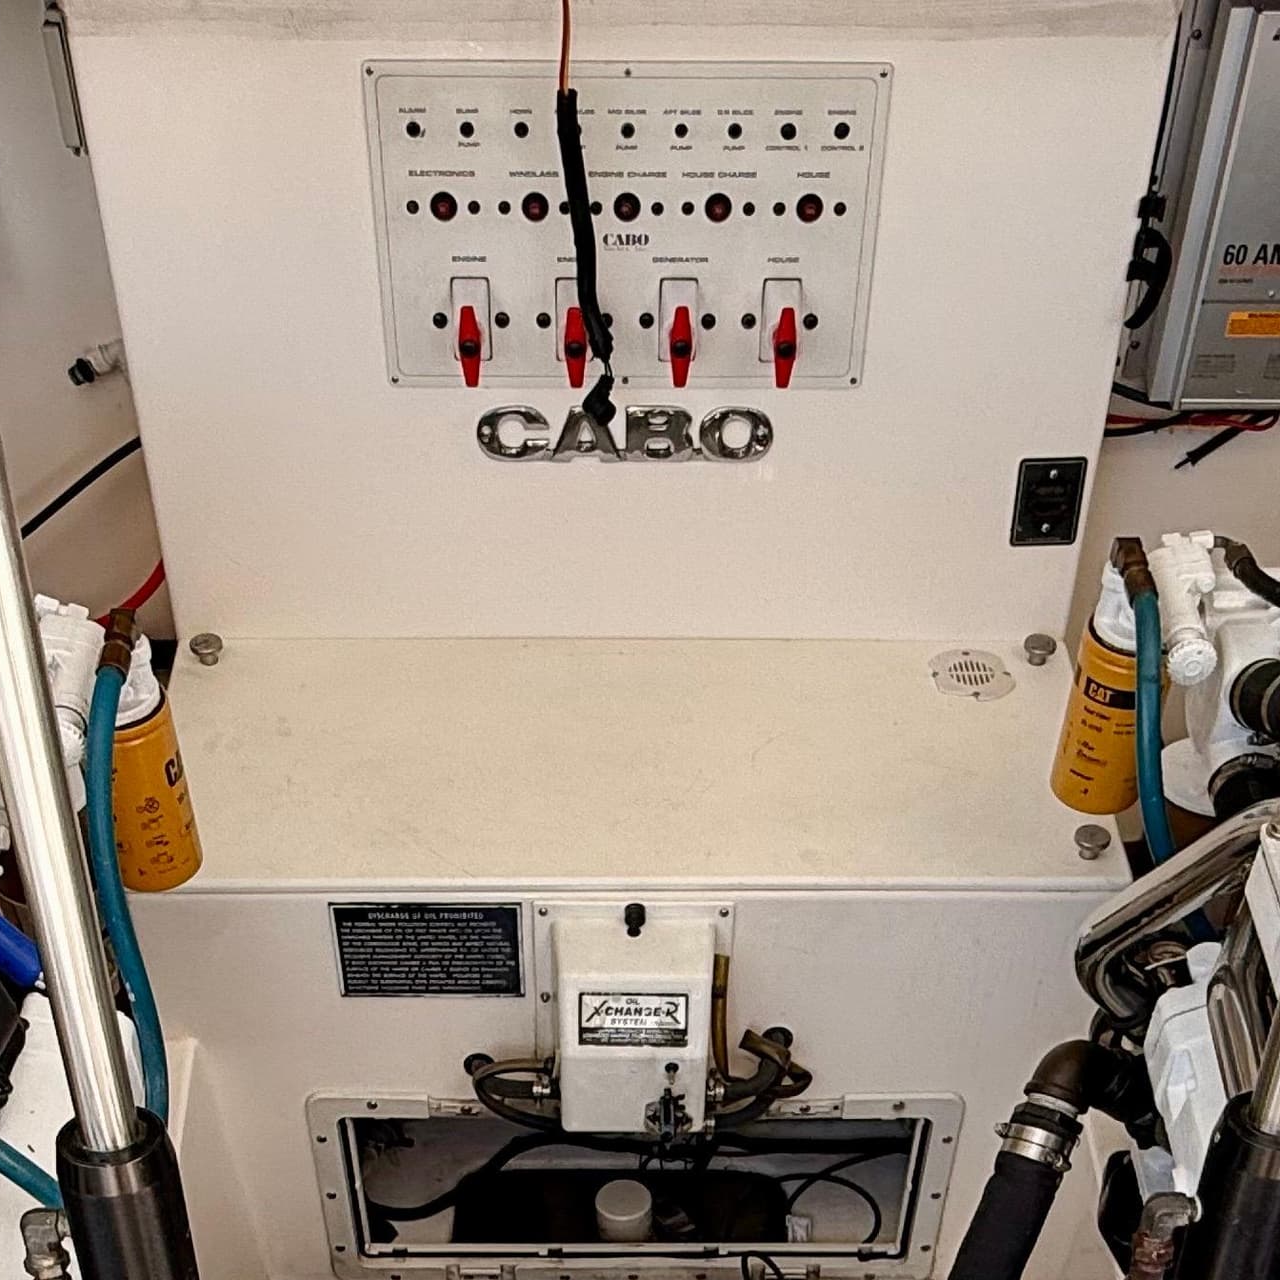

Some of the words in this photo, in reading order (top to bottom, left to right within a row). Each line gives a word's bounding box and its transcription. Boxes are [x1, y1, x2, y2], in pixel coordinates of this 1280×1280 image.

[408, 169, 476, 178] ELECTRONICS
[508, 170, 559, 178] WINDLASS
[682, 171, 715, 179] HOUSE
[717, 171, 758, 179] CHARGE
[602, 233, 650, 246] CABO
[451, 255, 487, 263] ENGINE
[1223, 244, 1248, 266] 60
[652, 256, 709, 264] GENERATOR
[767, 256, 800, 264] HOUSE
[476, 404, 774, 464] CABO
[1089, 682, 1113, 704] CAT
